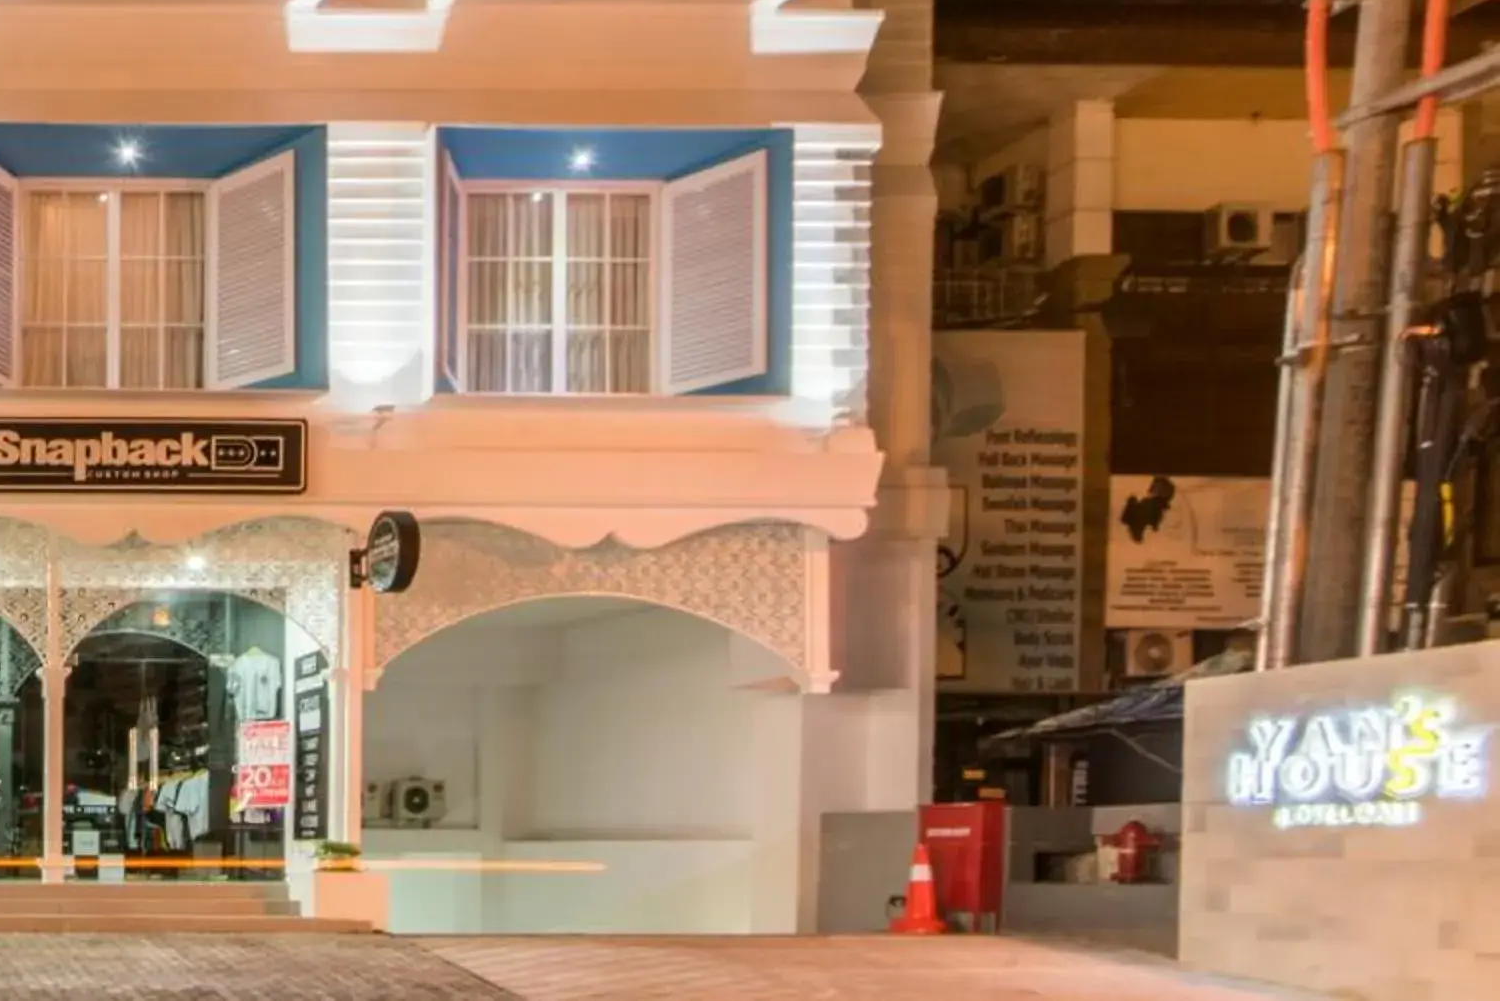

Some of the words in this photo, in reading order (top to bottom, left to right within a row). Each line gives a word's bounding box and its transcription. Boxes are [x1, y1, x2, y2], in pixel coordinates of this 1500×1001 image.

[1030, 451, 1077, 472] Massage
[1030, 474, 1077, 494] Massage
[1030, 496, 1076, 515] Massage
[1030, 519, 1076, 538] Massage
[1228, 729, 1490, 803] HOUSE
